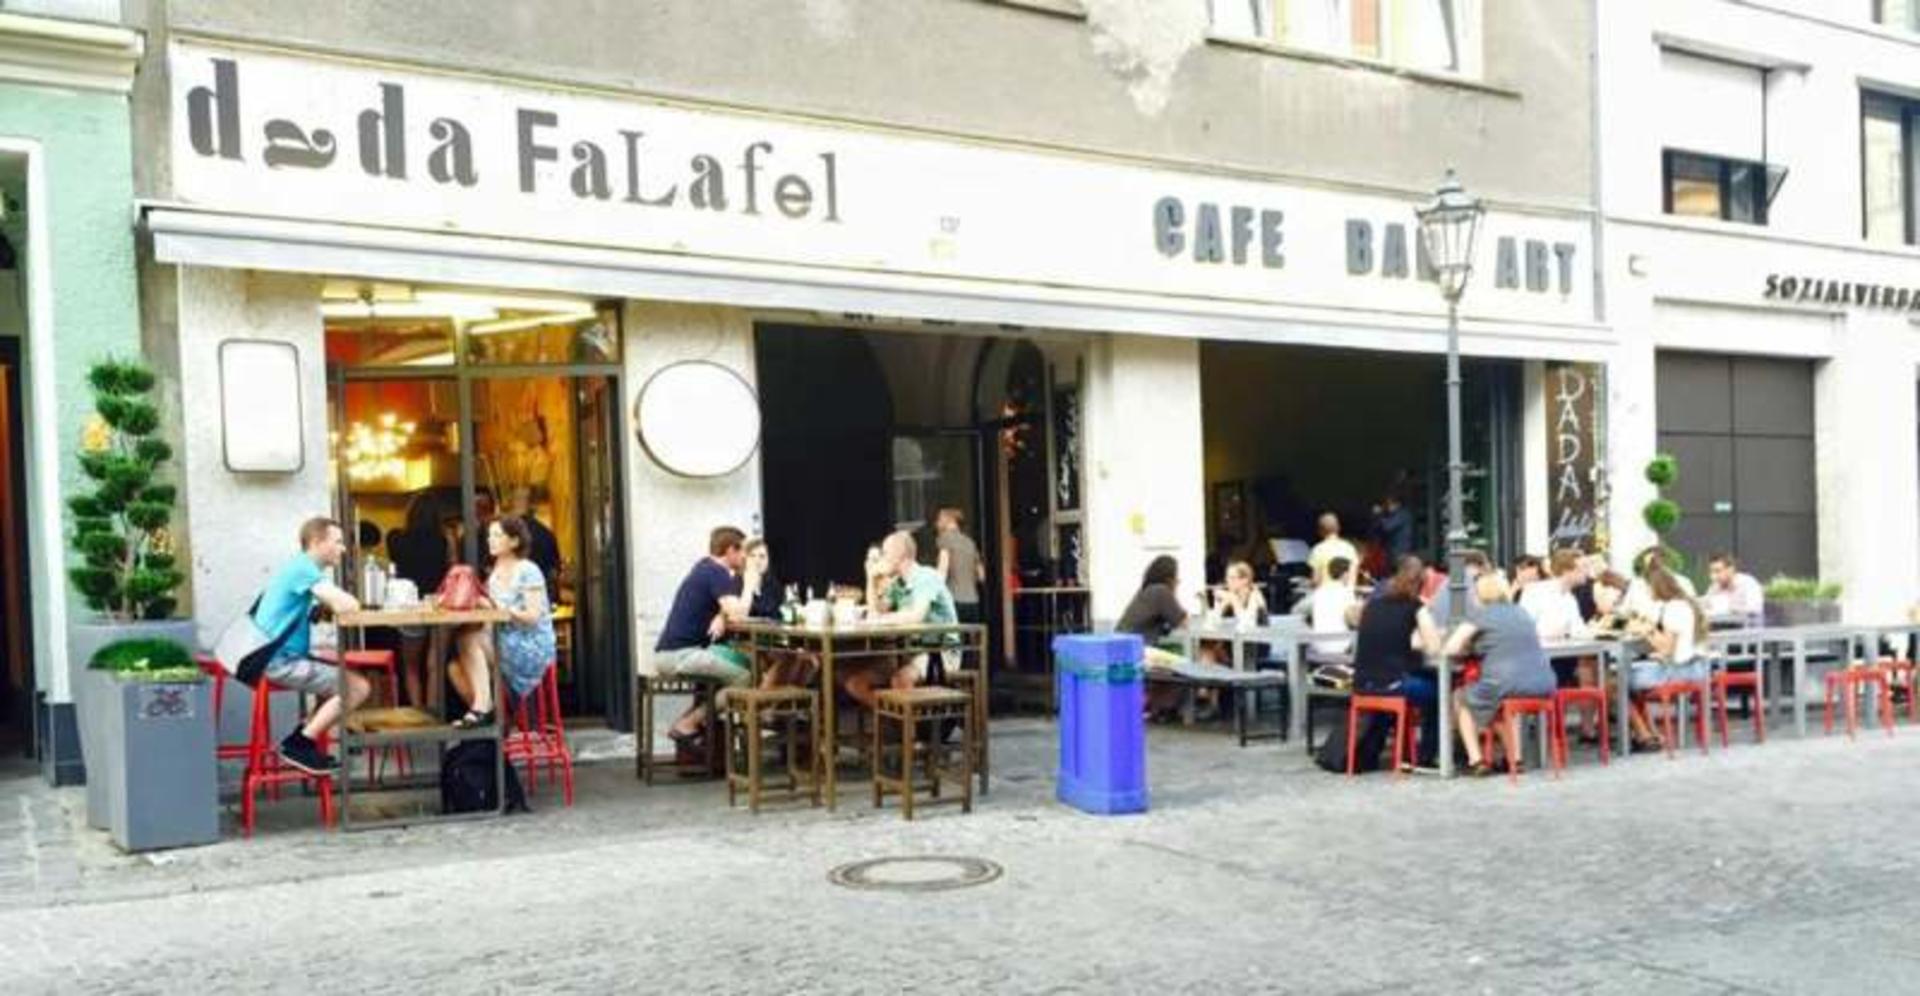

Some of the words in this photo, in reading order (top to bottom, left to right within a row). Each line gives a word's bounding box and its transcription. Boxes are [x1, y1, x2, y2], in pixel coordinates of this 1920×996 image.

[186, 57, 478, 187] dada
[1153, 196, 1286, 269] CAFE
[1495, 236, 1576, 295] ART
[1556, 367, 1586, 502] DADA
